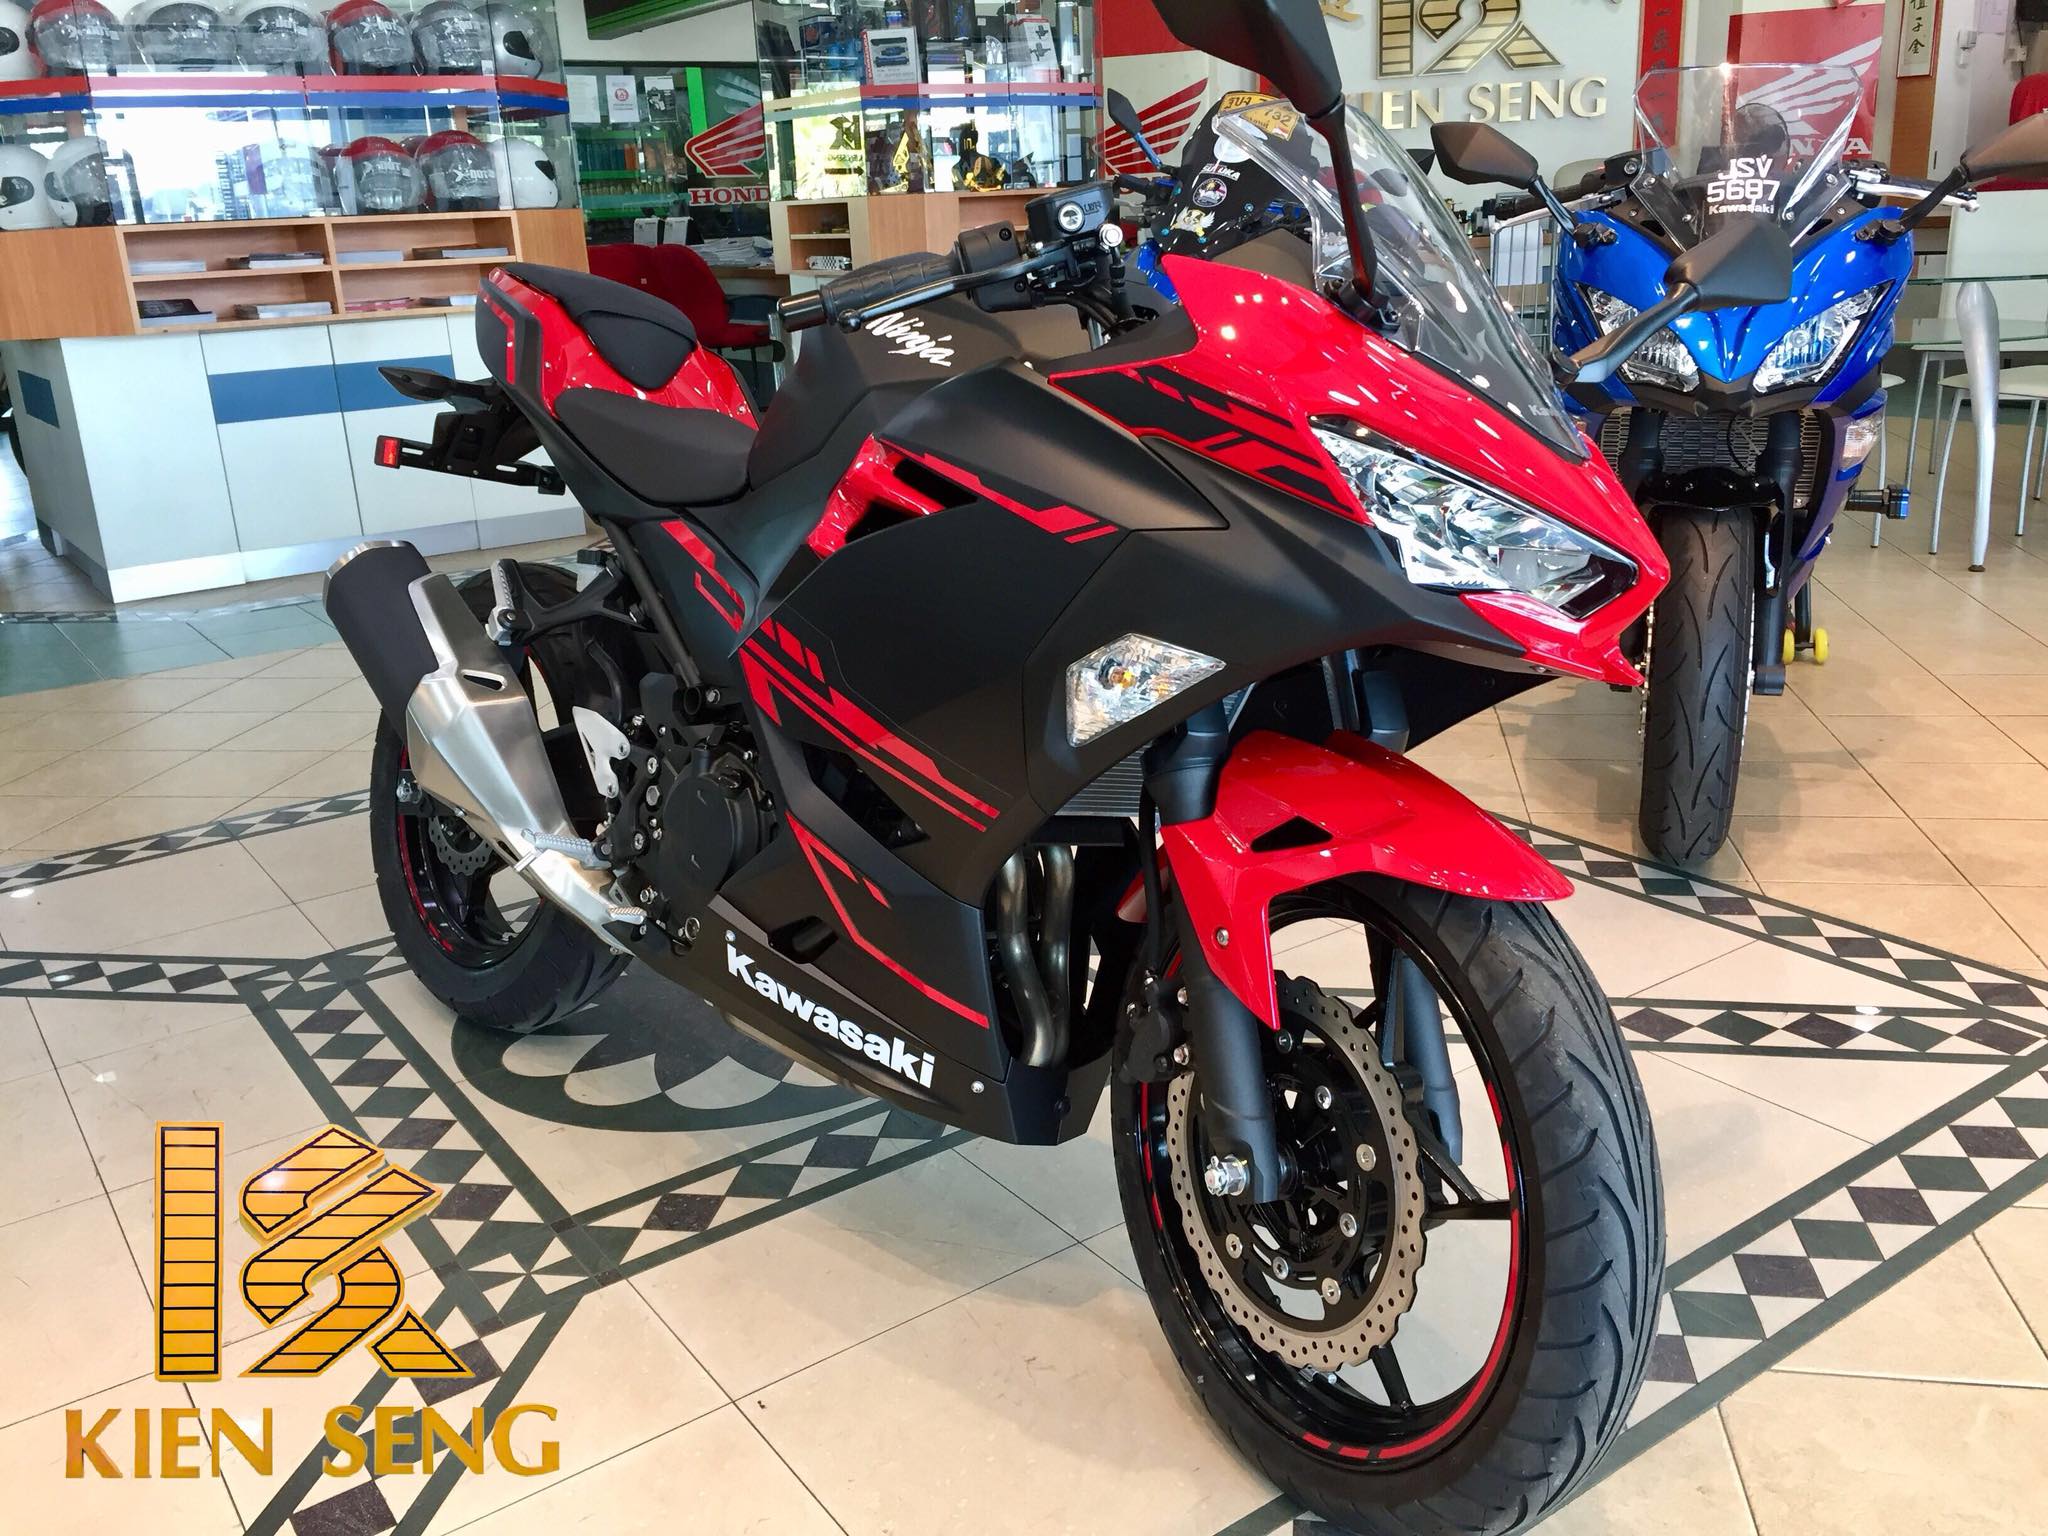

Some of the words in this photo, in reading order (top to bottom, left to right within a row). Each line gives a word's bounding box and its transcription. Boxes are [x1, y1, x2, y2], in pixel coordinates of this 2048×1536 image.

[1344, 88, 1444, 130] IEN
[1469, 76, 1608, 123] SENG
[1718, 157, 1773, 180] JSV
[1708, 203, 1775, 215] Kawasaki
[865, 312, 954, 367] Ninja
[726, 943, 935, 1088] Kawasaki
